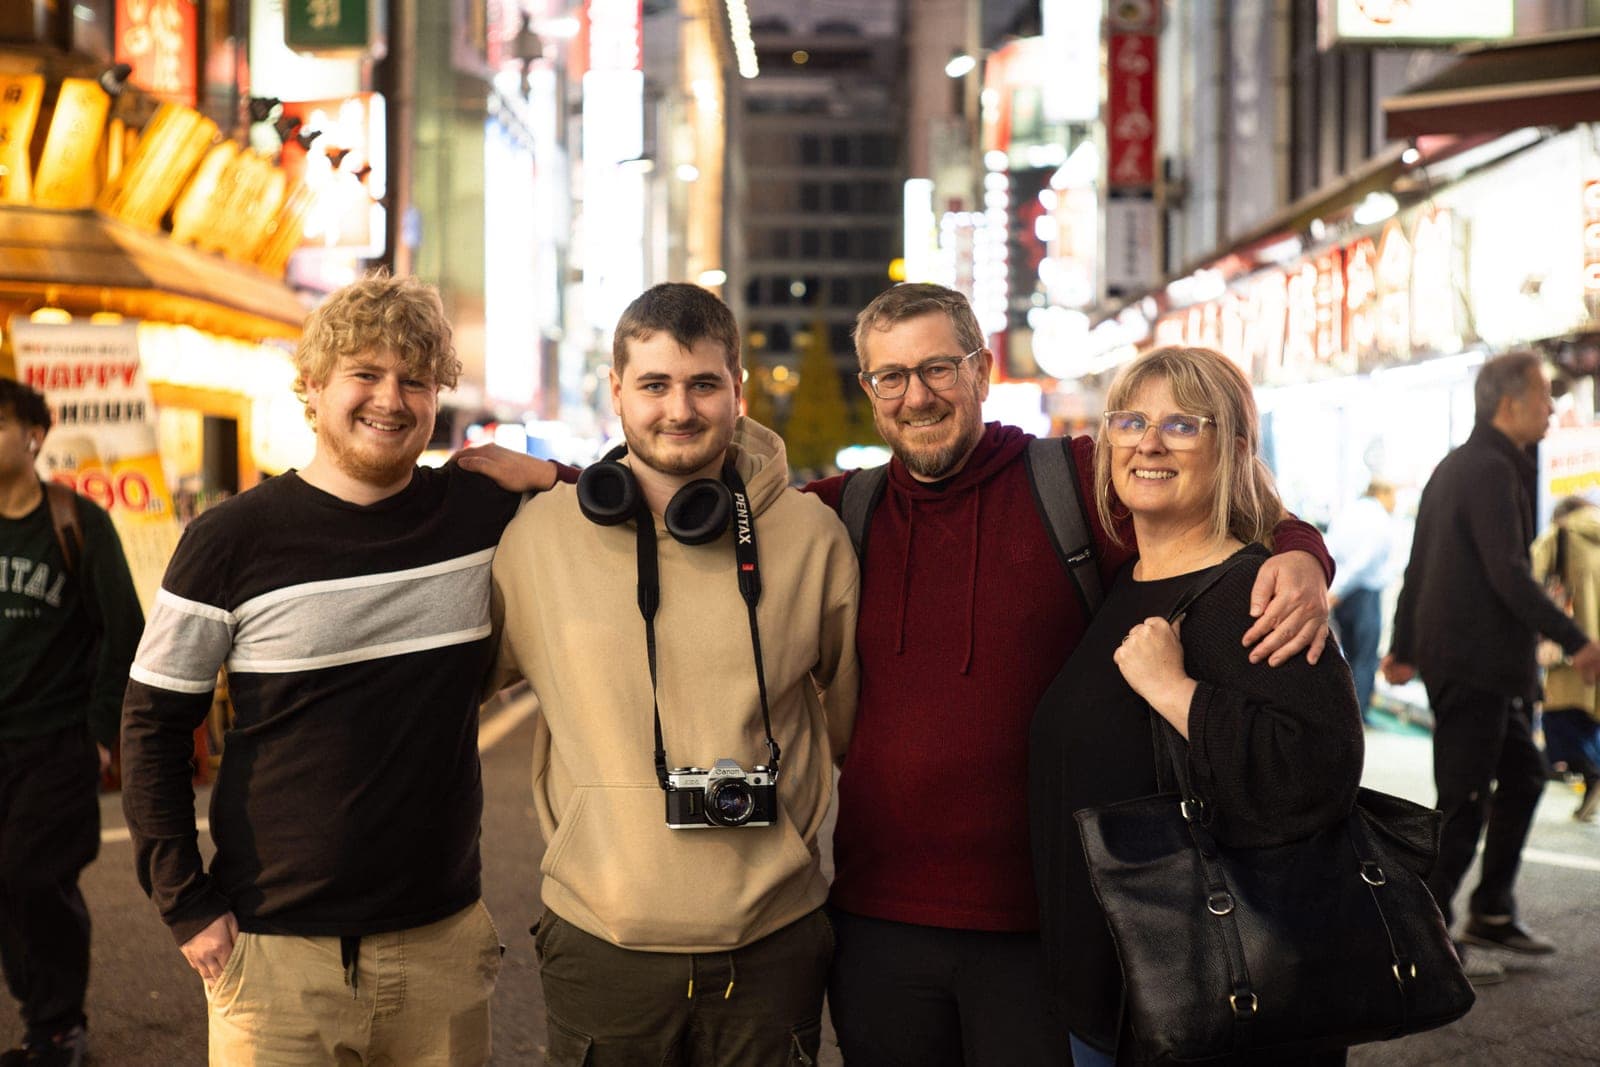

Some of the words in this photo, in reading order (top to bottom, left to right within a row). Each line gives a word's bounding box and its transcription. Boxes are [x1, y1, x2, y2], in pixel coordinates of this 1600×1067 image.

[26, 362, 138, 390] HAPPY
[60, 401, 146, 425] HOUR
[734, 492, 752, 544] PENTAX
